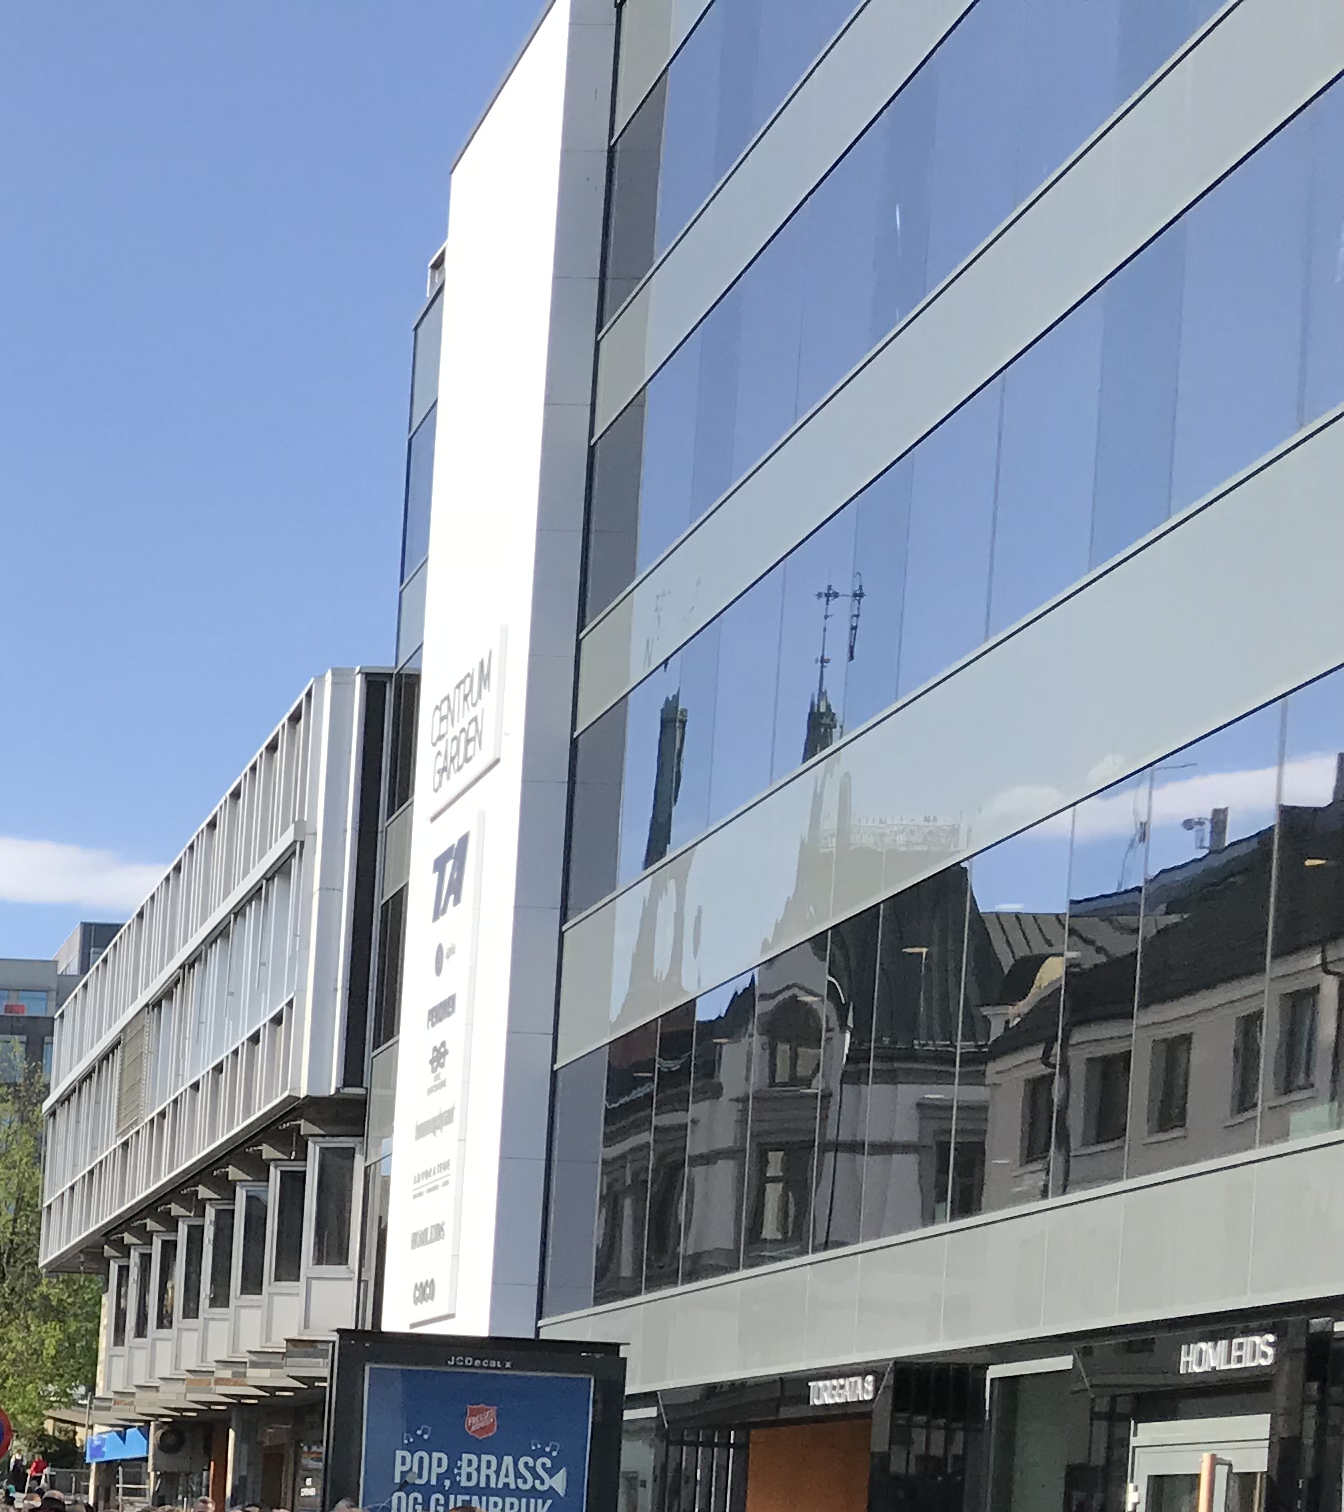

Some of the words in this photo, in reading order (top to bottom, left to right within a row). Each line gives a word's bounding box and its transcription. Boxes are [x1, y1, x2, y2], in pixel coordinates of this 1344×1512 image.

[431, 648, 492, 747] CENTRUM
[433, 707, 484, 793] GARDEN
[432, 830, 470, 924] TA
[394, 1450, 451, 1491] POP,
[460, 1453, 551, 1492] BRASS
